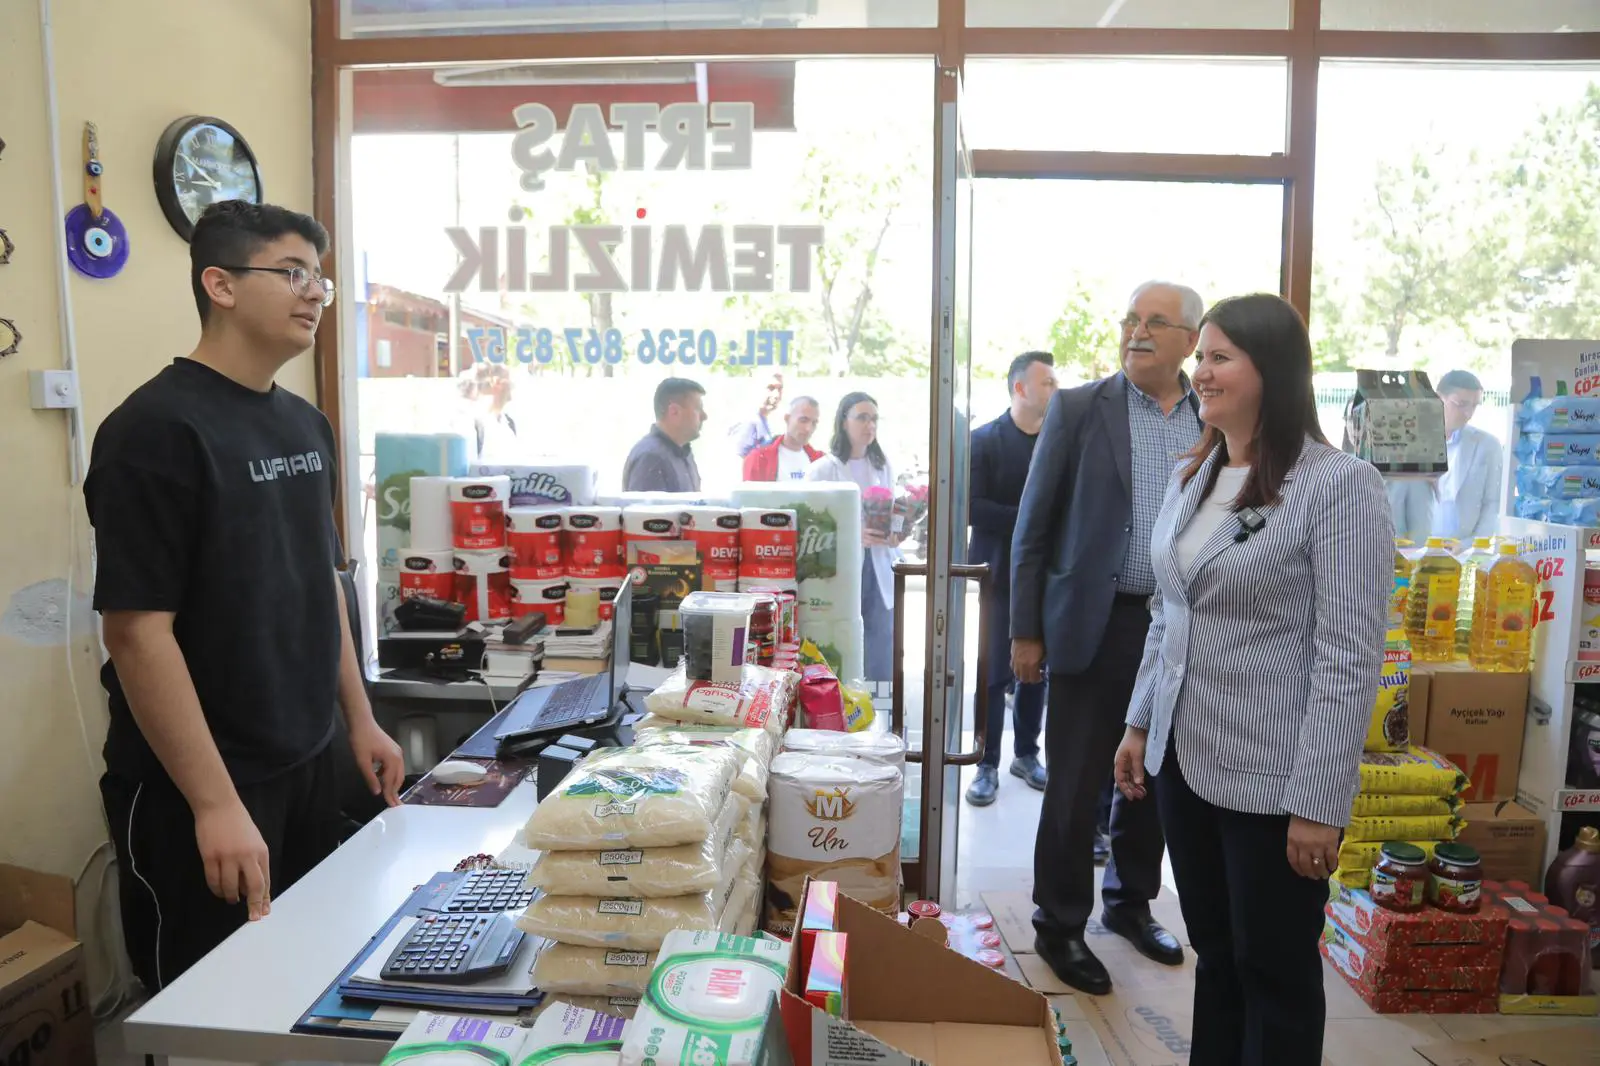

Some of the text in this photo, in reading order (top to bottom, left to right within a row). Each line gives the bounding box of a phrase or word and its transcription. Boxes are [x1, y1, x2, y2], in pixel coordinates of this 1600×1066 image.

[248, 451, 322, 482] LUFIAN
[755, 545, 780, 556] DEV
[808, 826, 849, 851] Un
[670, 971, 687, 998] POWER
[705, 968, 748, 1000] FAIRY
